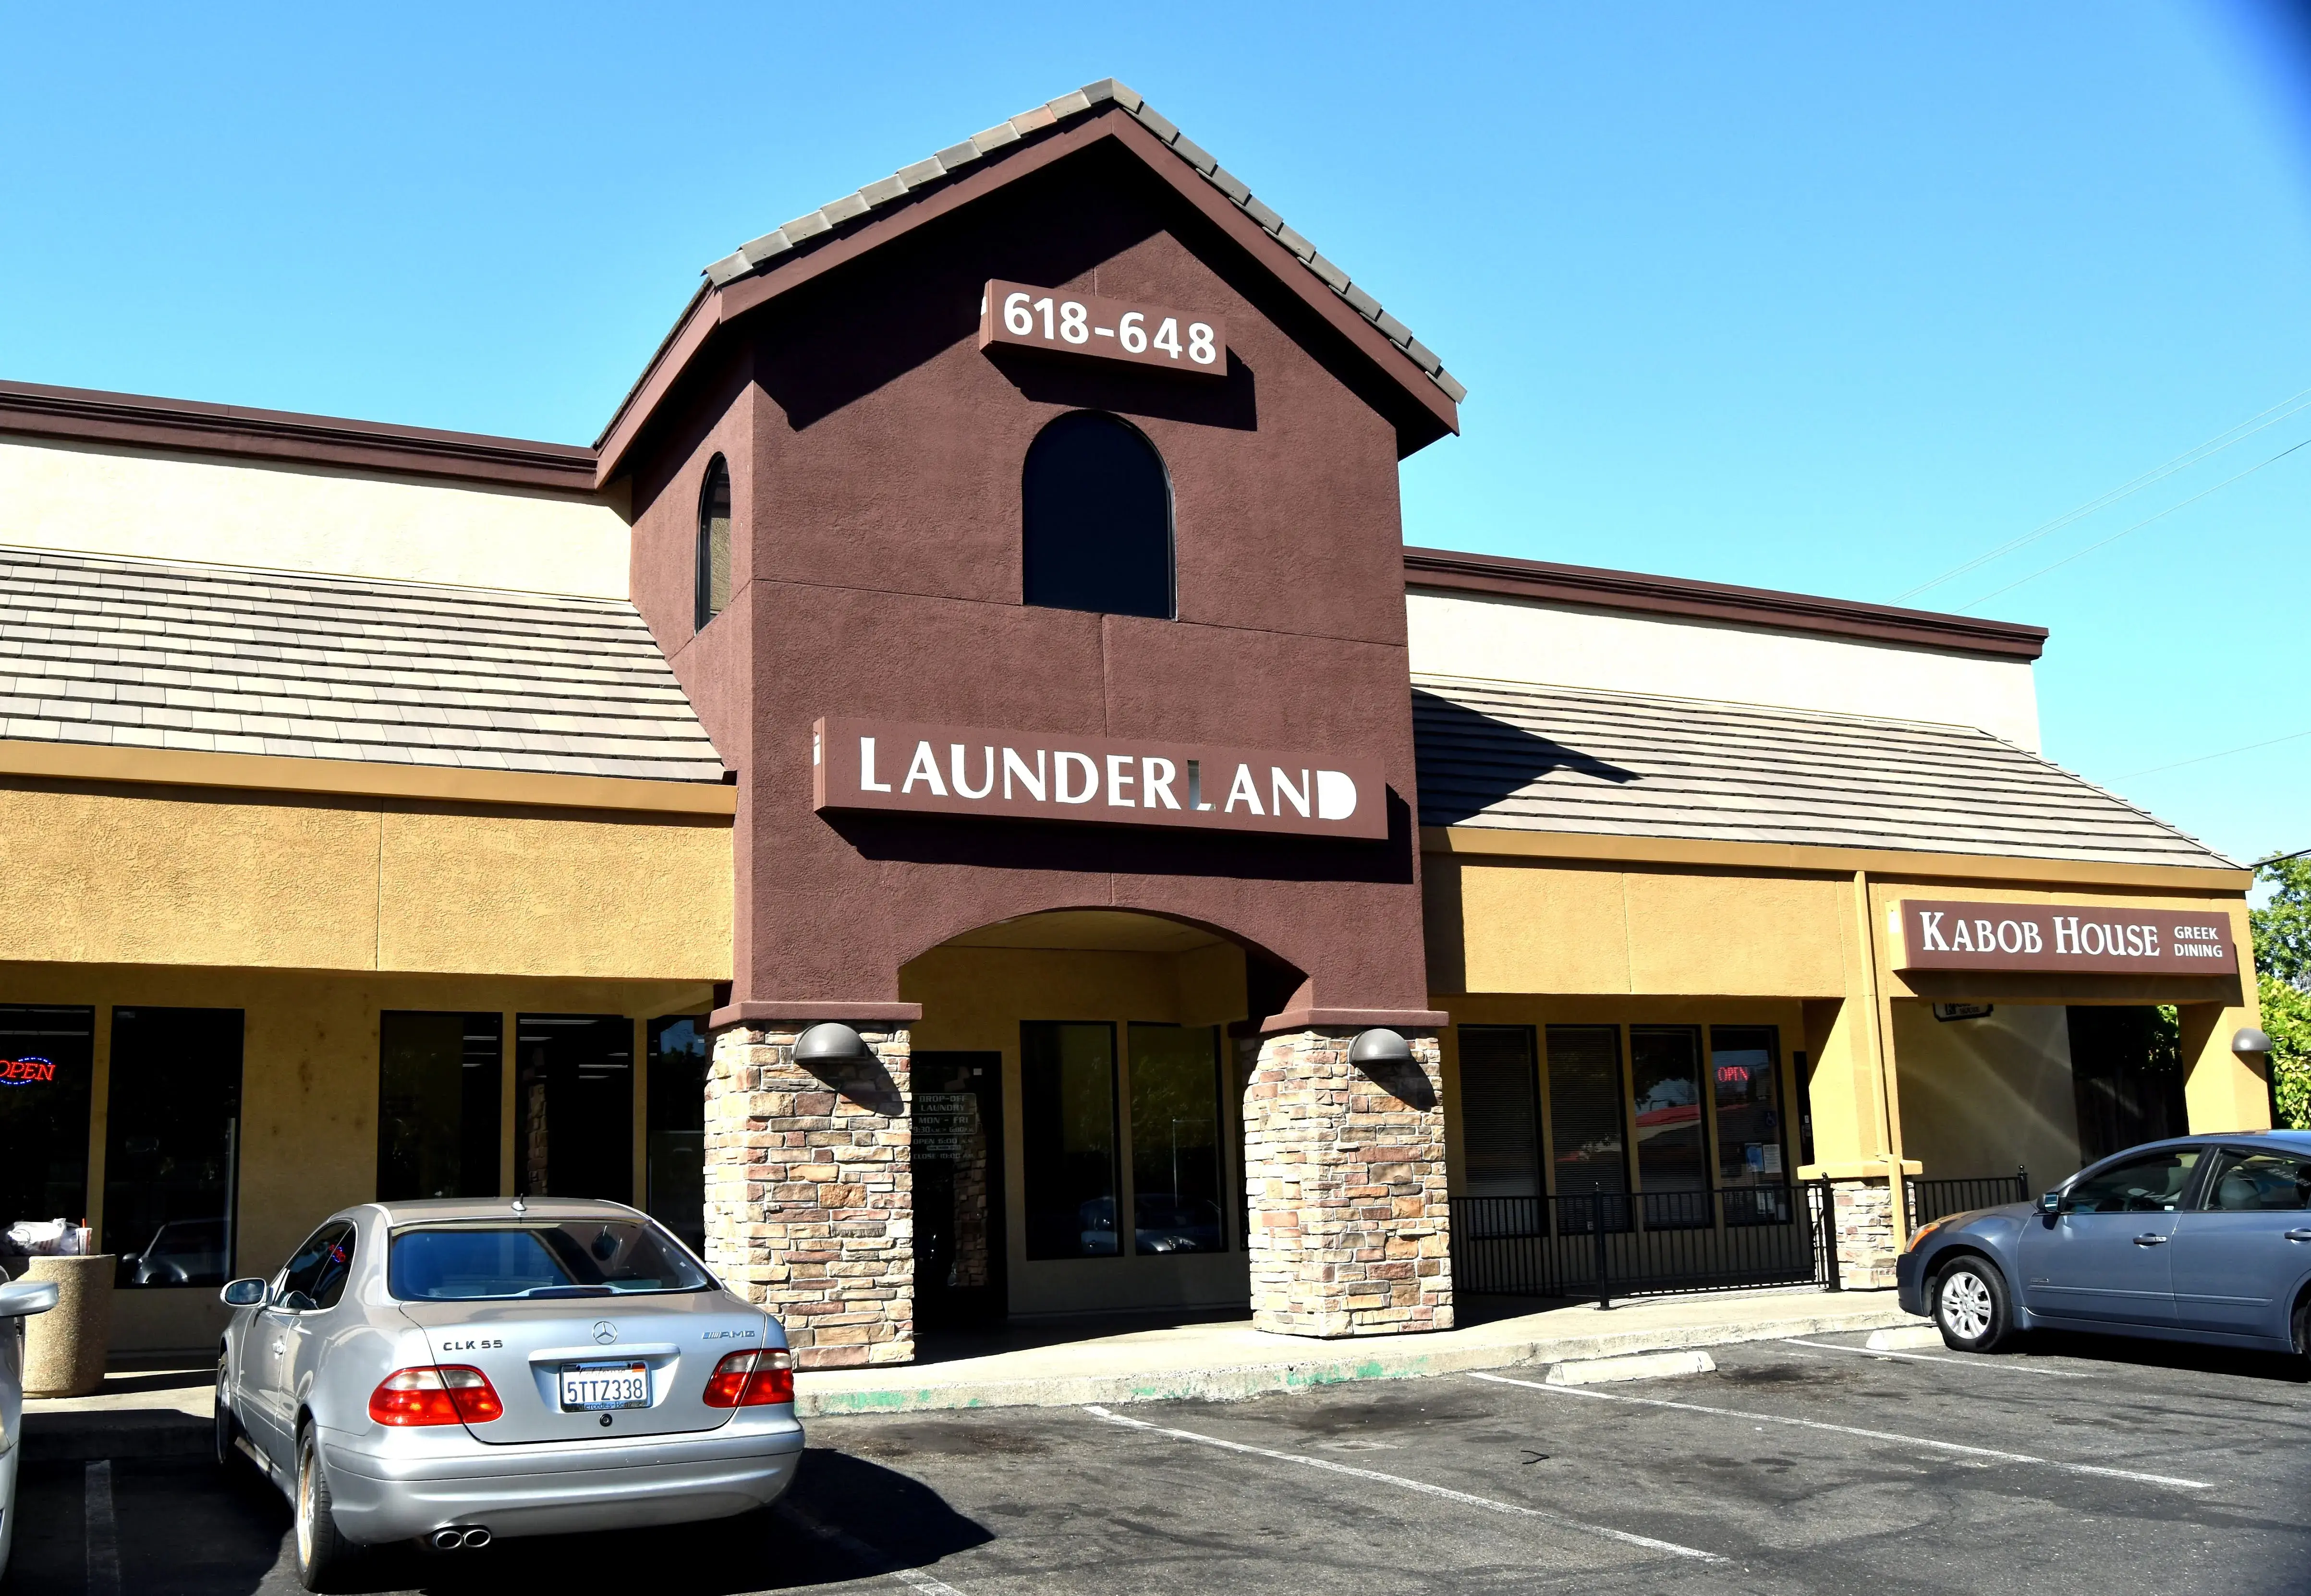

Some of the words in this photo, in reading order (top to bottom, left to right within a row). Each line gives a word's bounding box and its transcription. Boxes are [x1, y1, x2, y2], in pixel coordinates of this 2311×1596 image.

[1003, 292, 1216, 365] 618-648
[860, 736, 1357, 821] LAUNDERLAND
[1919, 911, 2043, 954] KABOB
[2053, 916, 2160, 957] HOUSE
[2174, 925, 2220, 941] GREEK
[2174, 943, 2223, 958] DINING
[720, 1330, 755, 1338] AMG
[443, 1341, 476, 1351] CLK
[481, 1340, 503, 1349] 55
[567, 1378, 643, 1403] 5TTZ338
[578, 1401, 632, 1410] Mercedes-Benz
